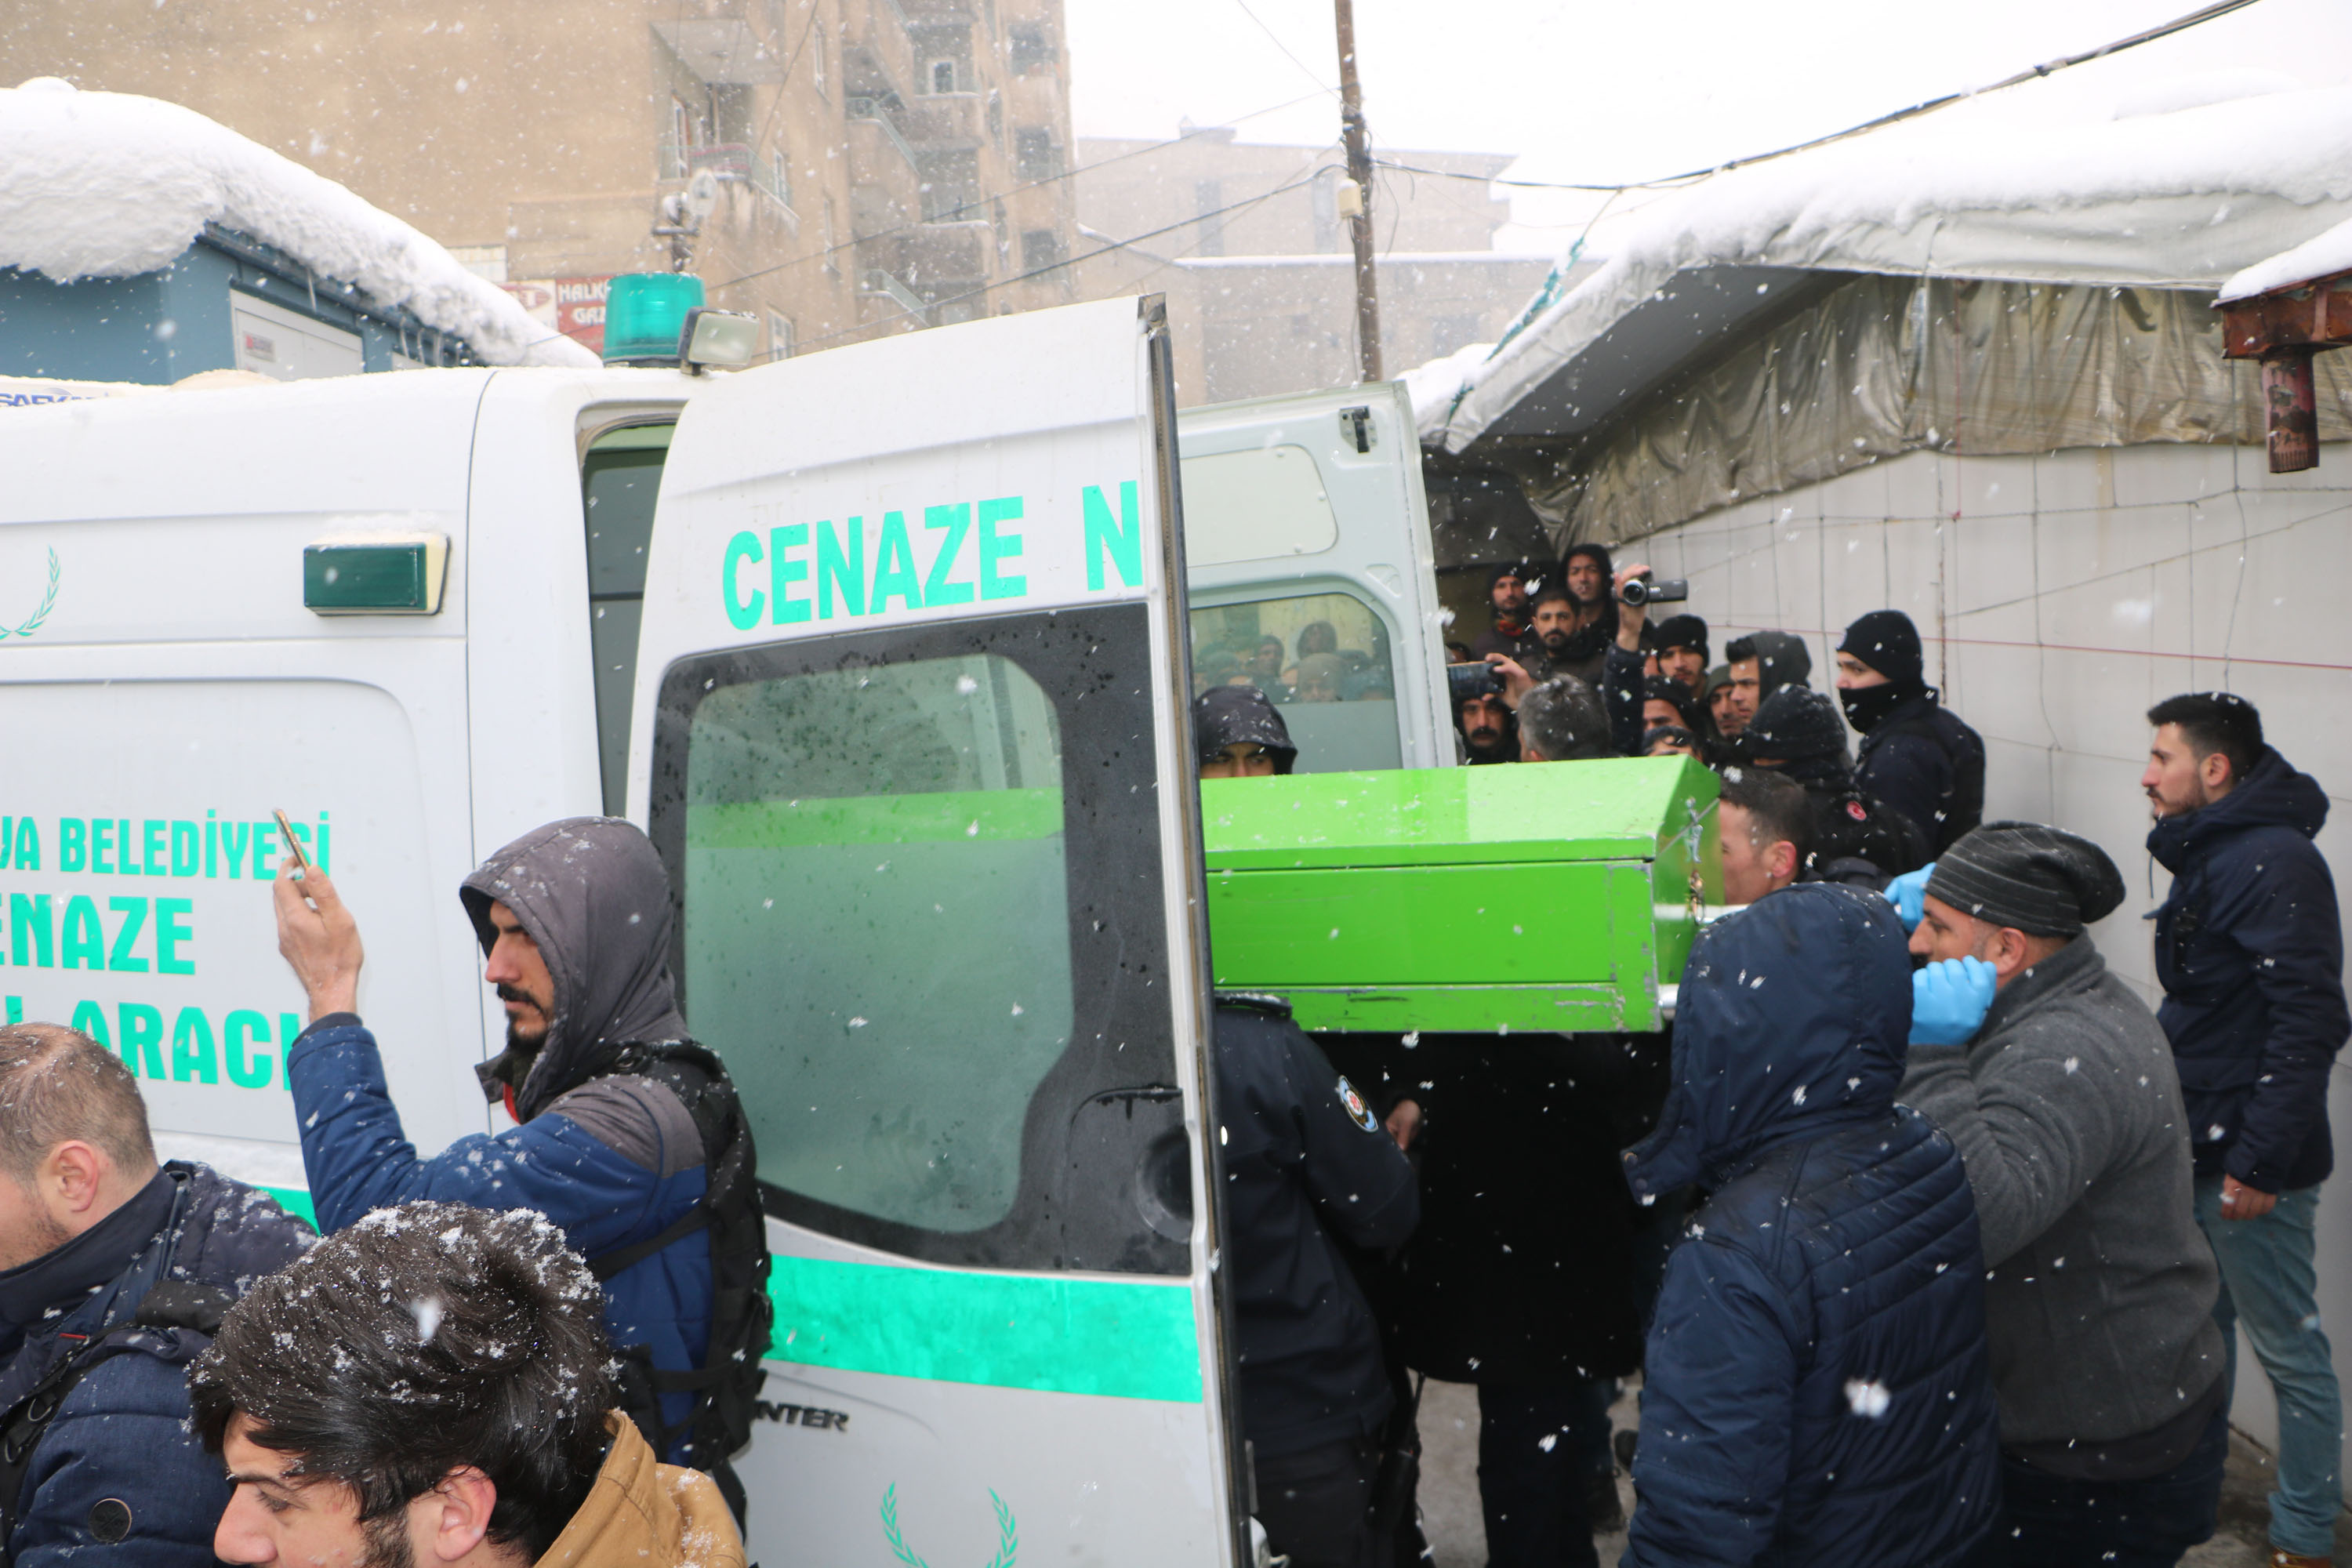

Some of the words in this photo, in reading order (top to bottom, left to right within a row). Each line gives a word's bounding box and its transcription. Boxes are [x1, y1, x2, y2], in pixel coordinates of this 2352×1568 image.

[722, 495, 1028, 631] CENAZE
[1081, 479, 1144, 592] N
[0, 892, 195, 975] NAZE
